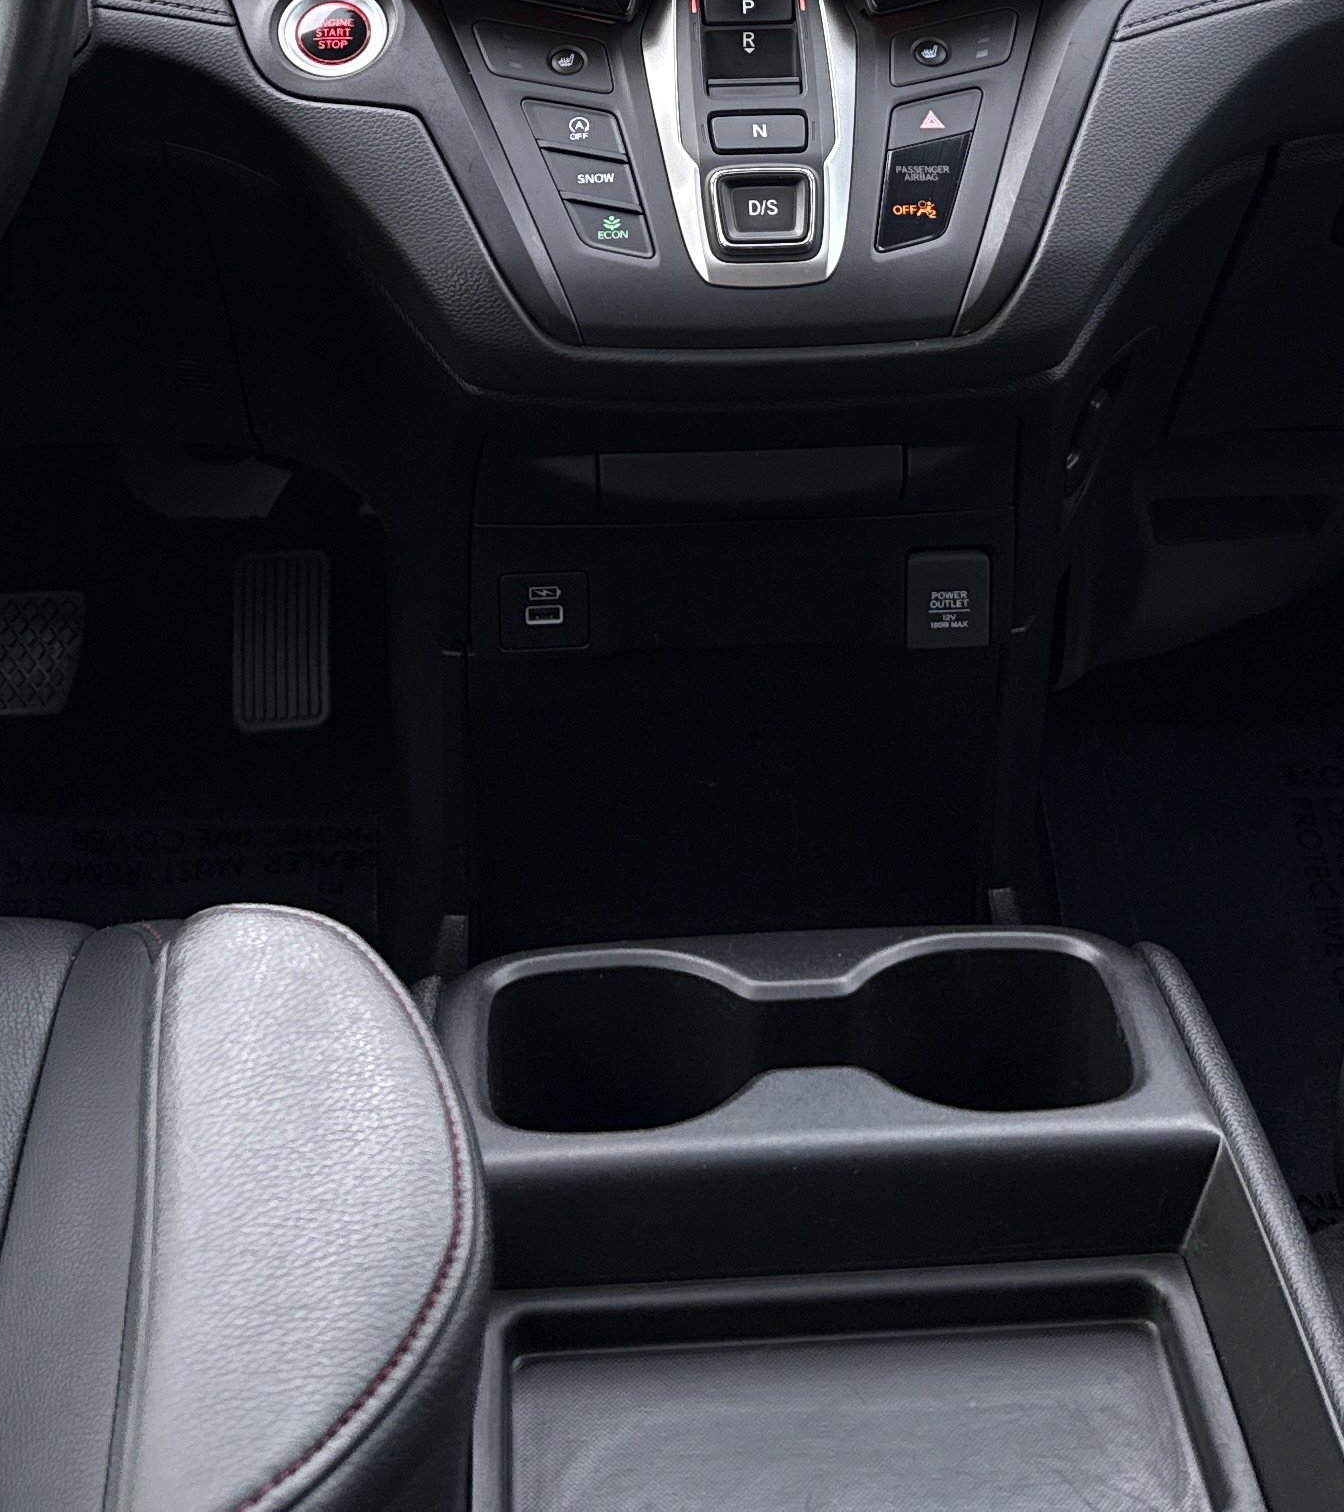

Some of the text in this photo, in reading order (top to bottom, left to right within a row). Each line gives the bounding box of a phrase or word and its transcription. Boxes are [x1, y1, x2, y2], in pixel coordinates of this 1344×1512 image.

[742, 0, 755, 15] P
[319, 18, 355, 27] NGINE
[316, 28, 351, 37] START
[742, 31, 755, 48] R
[317, 40, 348, 49] STOP
[752, 123, 768, 138] N
[569, 132, 589, 141] OFF
[895, 165, 950, 174] PASSENGER
[577, 173, 615, 184] SNOW
[904, 172, 938, 182] AIRBAG
[748, 199, 778, 216] D/S
[892, 204, 917, 216] OFF
[597, 230, 628, 239] ECON
[931, 590, 967, 600] POWER
[929, 599, 969, 608] OUTLET
[950, 620, 968, 628] MAX
